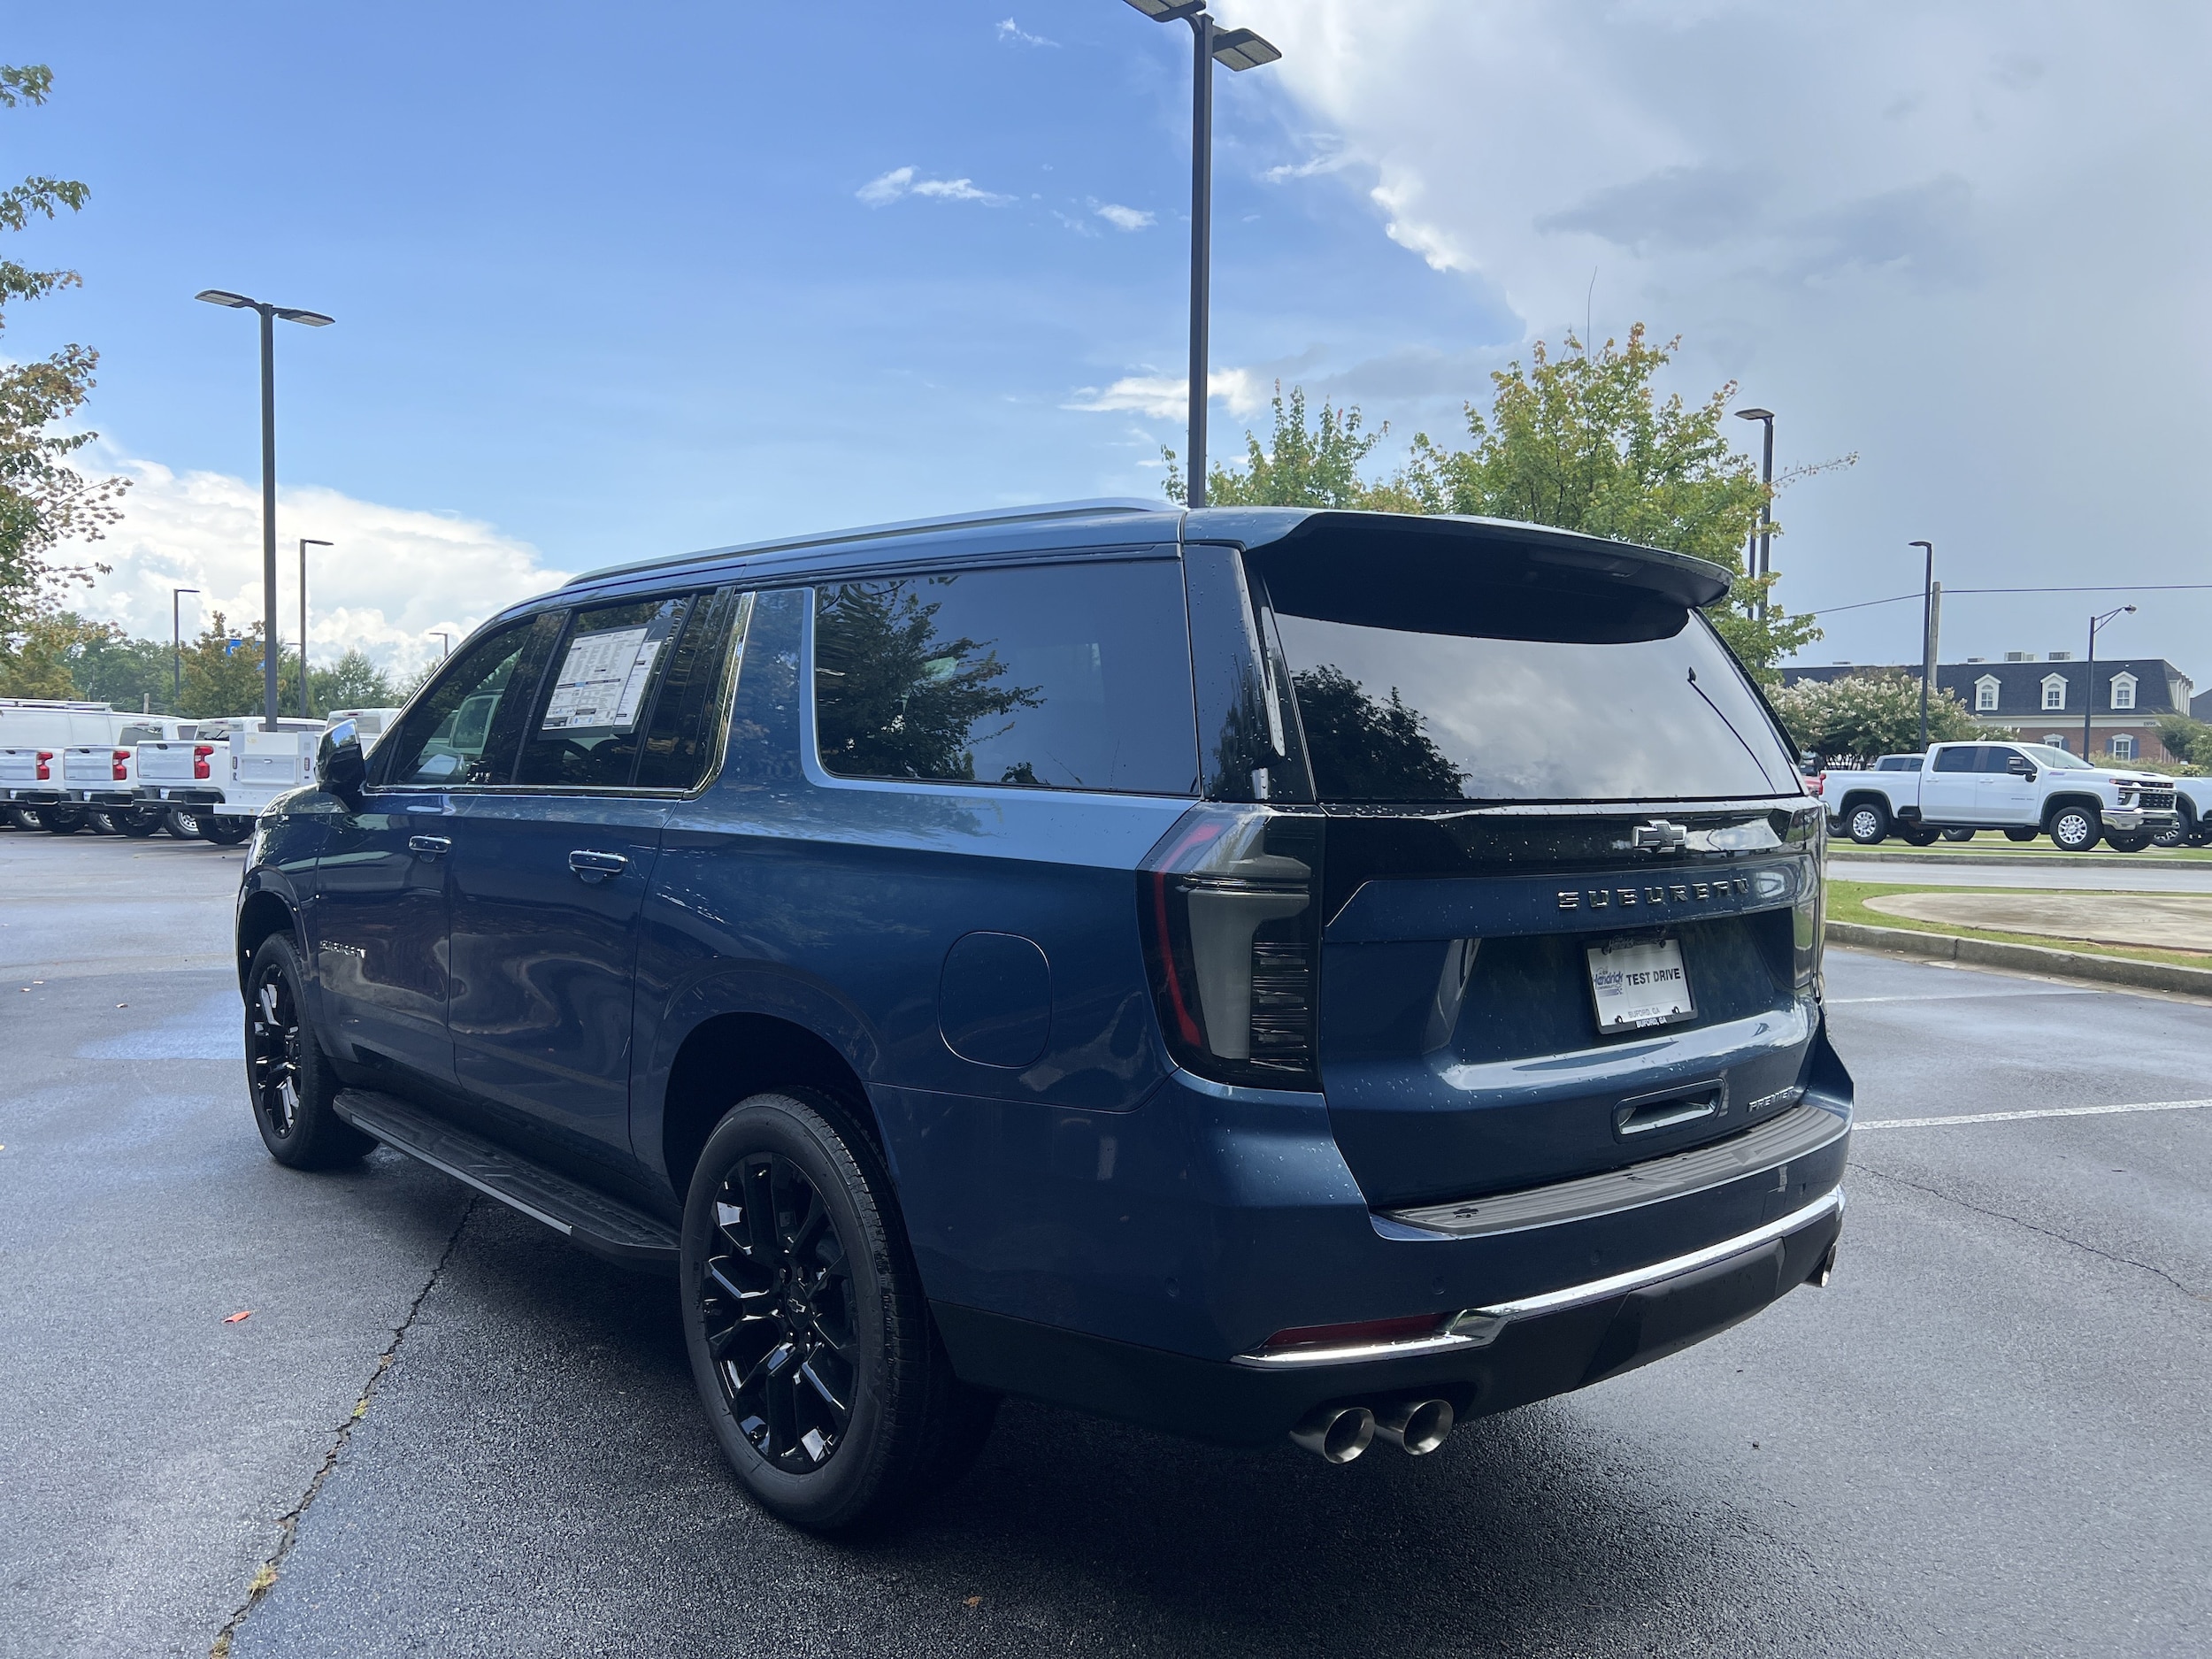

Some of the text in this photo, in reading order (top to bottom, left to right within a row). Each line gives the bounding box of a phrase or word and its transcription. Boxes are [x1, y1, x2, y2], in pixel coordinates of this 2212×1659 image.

[1557, 879, 1749, 909] SUBURBAN
[1626, 968, 1681, 987] TEST DRIVE
[1628, 1009, 1653, 1018] BUFORD,
[1636, 1018, 1659, 1028] BUFORD,
[1748, 1086, 1794, 1113] PREMIER
